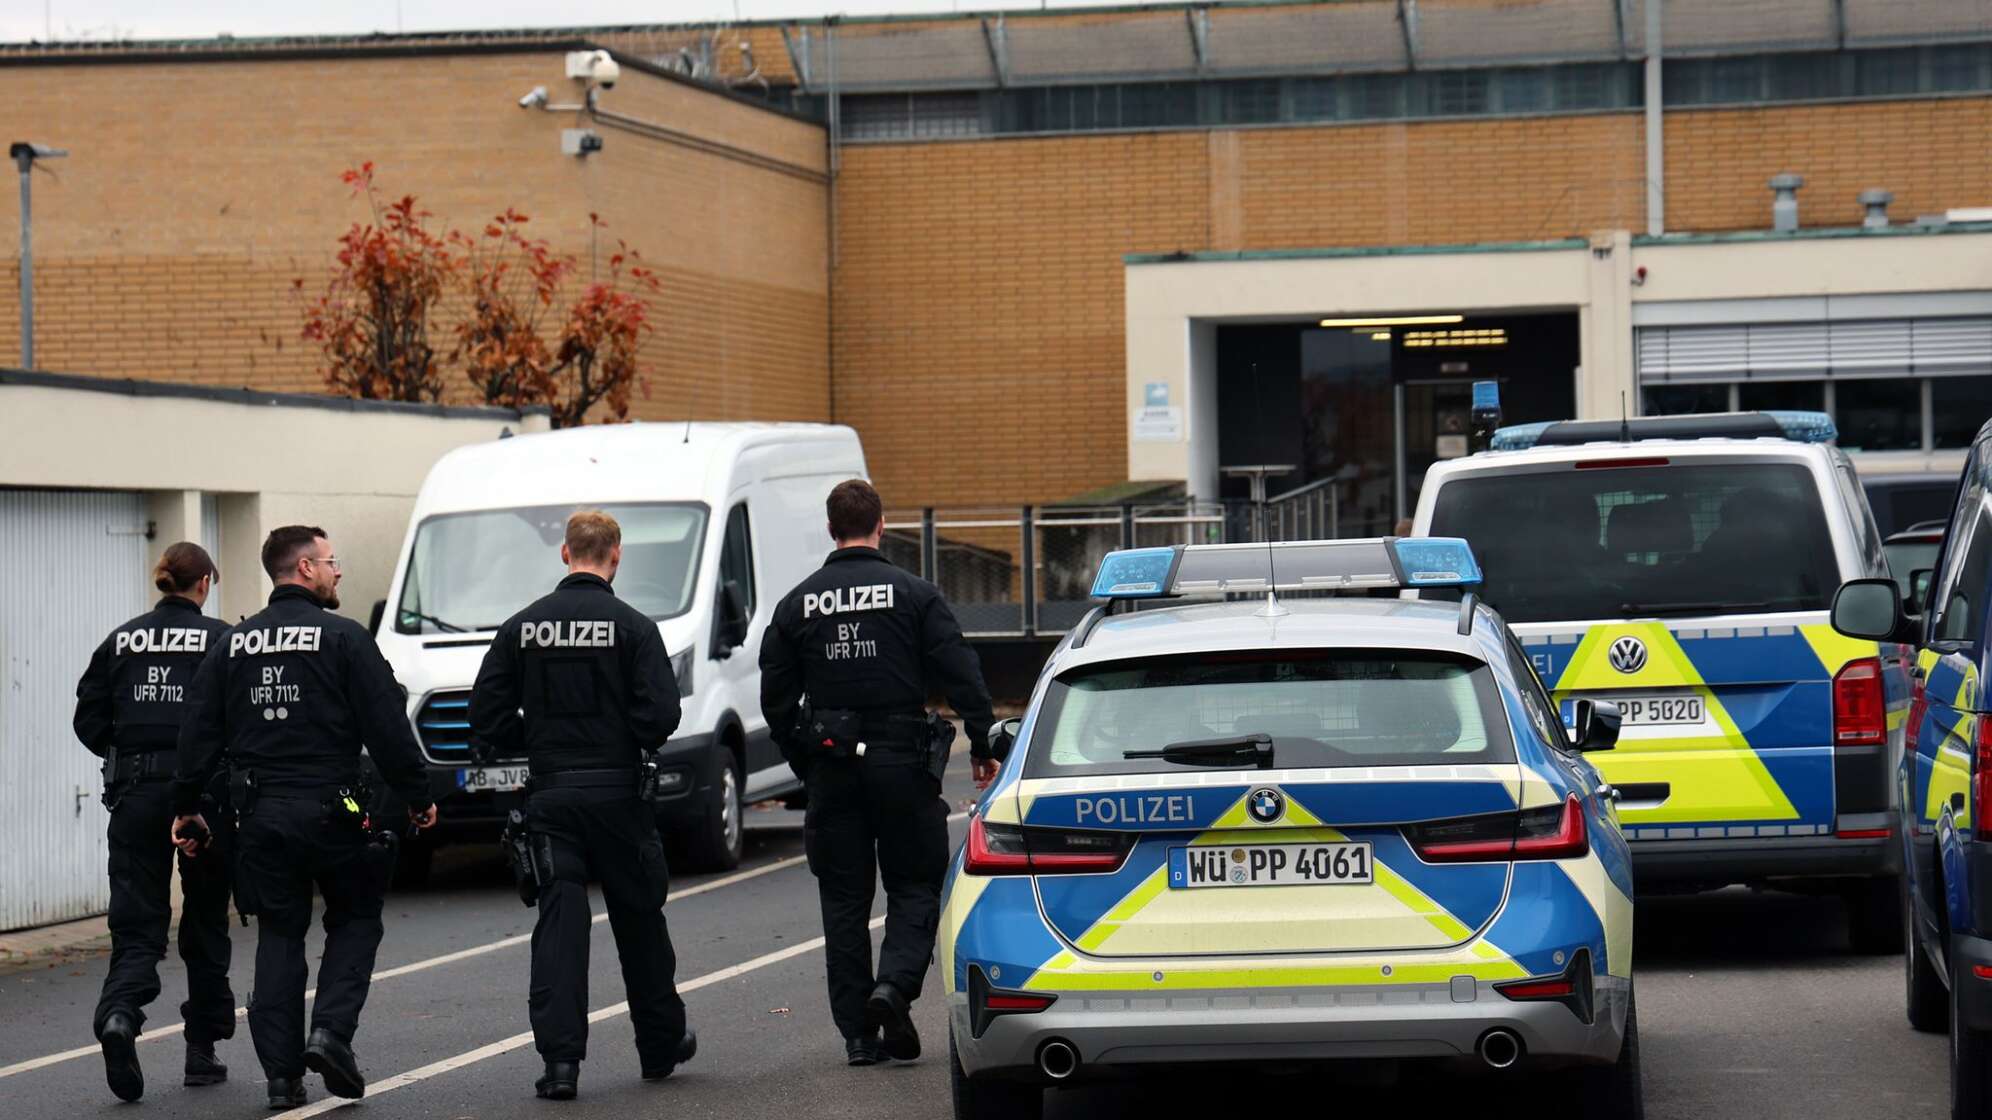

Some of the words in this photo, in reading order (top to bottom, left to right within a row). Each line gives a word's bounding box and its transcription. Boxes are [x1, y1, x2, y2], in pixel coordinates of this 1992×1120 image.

[803, 584, 894, 618] POLIZEI
[116, 628, 208, 656] POLIZEI
[229, 626, 322, 658] POLIZEI
[520, 620, 615, 648] POLIZEI
[837, 622, 860, 641] BY
[825, 641, 850, 660] UFR
[853, 639, 877, 658] 7111
[147, 665, 172, 684] BY
[262, 665, 285, 685] BY
[1532, 653, 1552, 675] EI
[133, 684, 157, 702] UFR
[160, 684, 184, 702] 7112
[250, 686, 273, 705] UFR
[275, 684, 300, 703] 7112
[1618, 700, 1642, 721] PP
[1648, 699, 1699, 721] 5020
[466, 769, 487, 786] AB
[498, 769, 518, 786] JV
[1075, 795, 1194, 824] POLIZEI
[1174, 871, 1182, 881] D
[1249, 848, 1287, 881] PP
[1295, 846, 1369, 880] 4061
